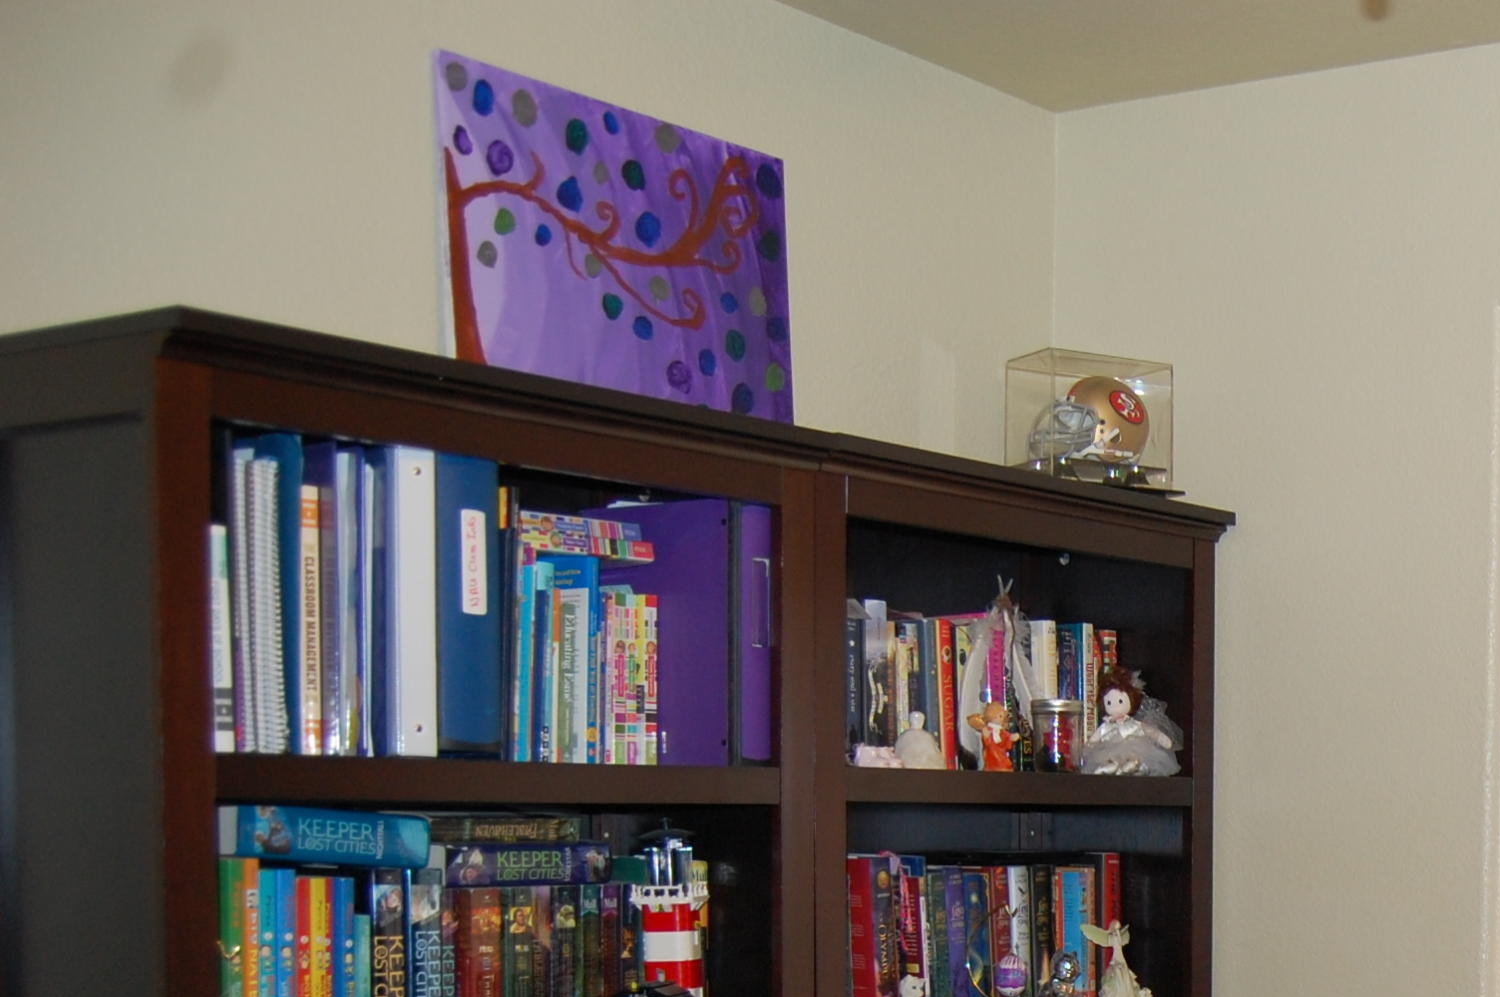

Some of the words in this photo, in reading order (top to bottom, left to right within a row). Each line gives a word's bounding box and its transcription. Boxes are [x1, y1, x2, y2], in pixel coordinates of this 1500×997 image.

[304, 555, 318, 618] CLASSROOM
[305, 620, 318, 693] MANAGEMENT
[561, 612, 577, 669] Educating
[942, 674, 954, 732] SUGAR
[297, 818, 375, 842] KEEPER
[297, 837, 333, 853] LOST
[334, 840, 377, 856] CITIES
[496, 850, 564, 868] KEEPER
[496, 867, 528, 882] LOST
[528, 867, 568, 882] CITIES
[373, 935, 389, 981] LOST
[415, 930, 429, 968] LOST
